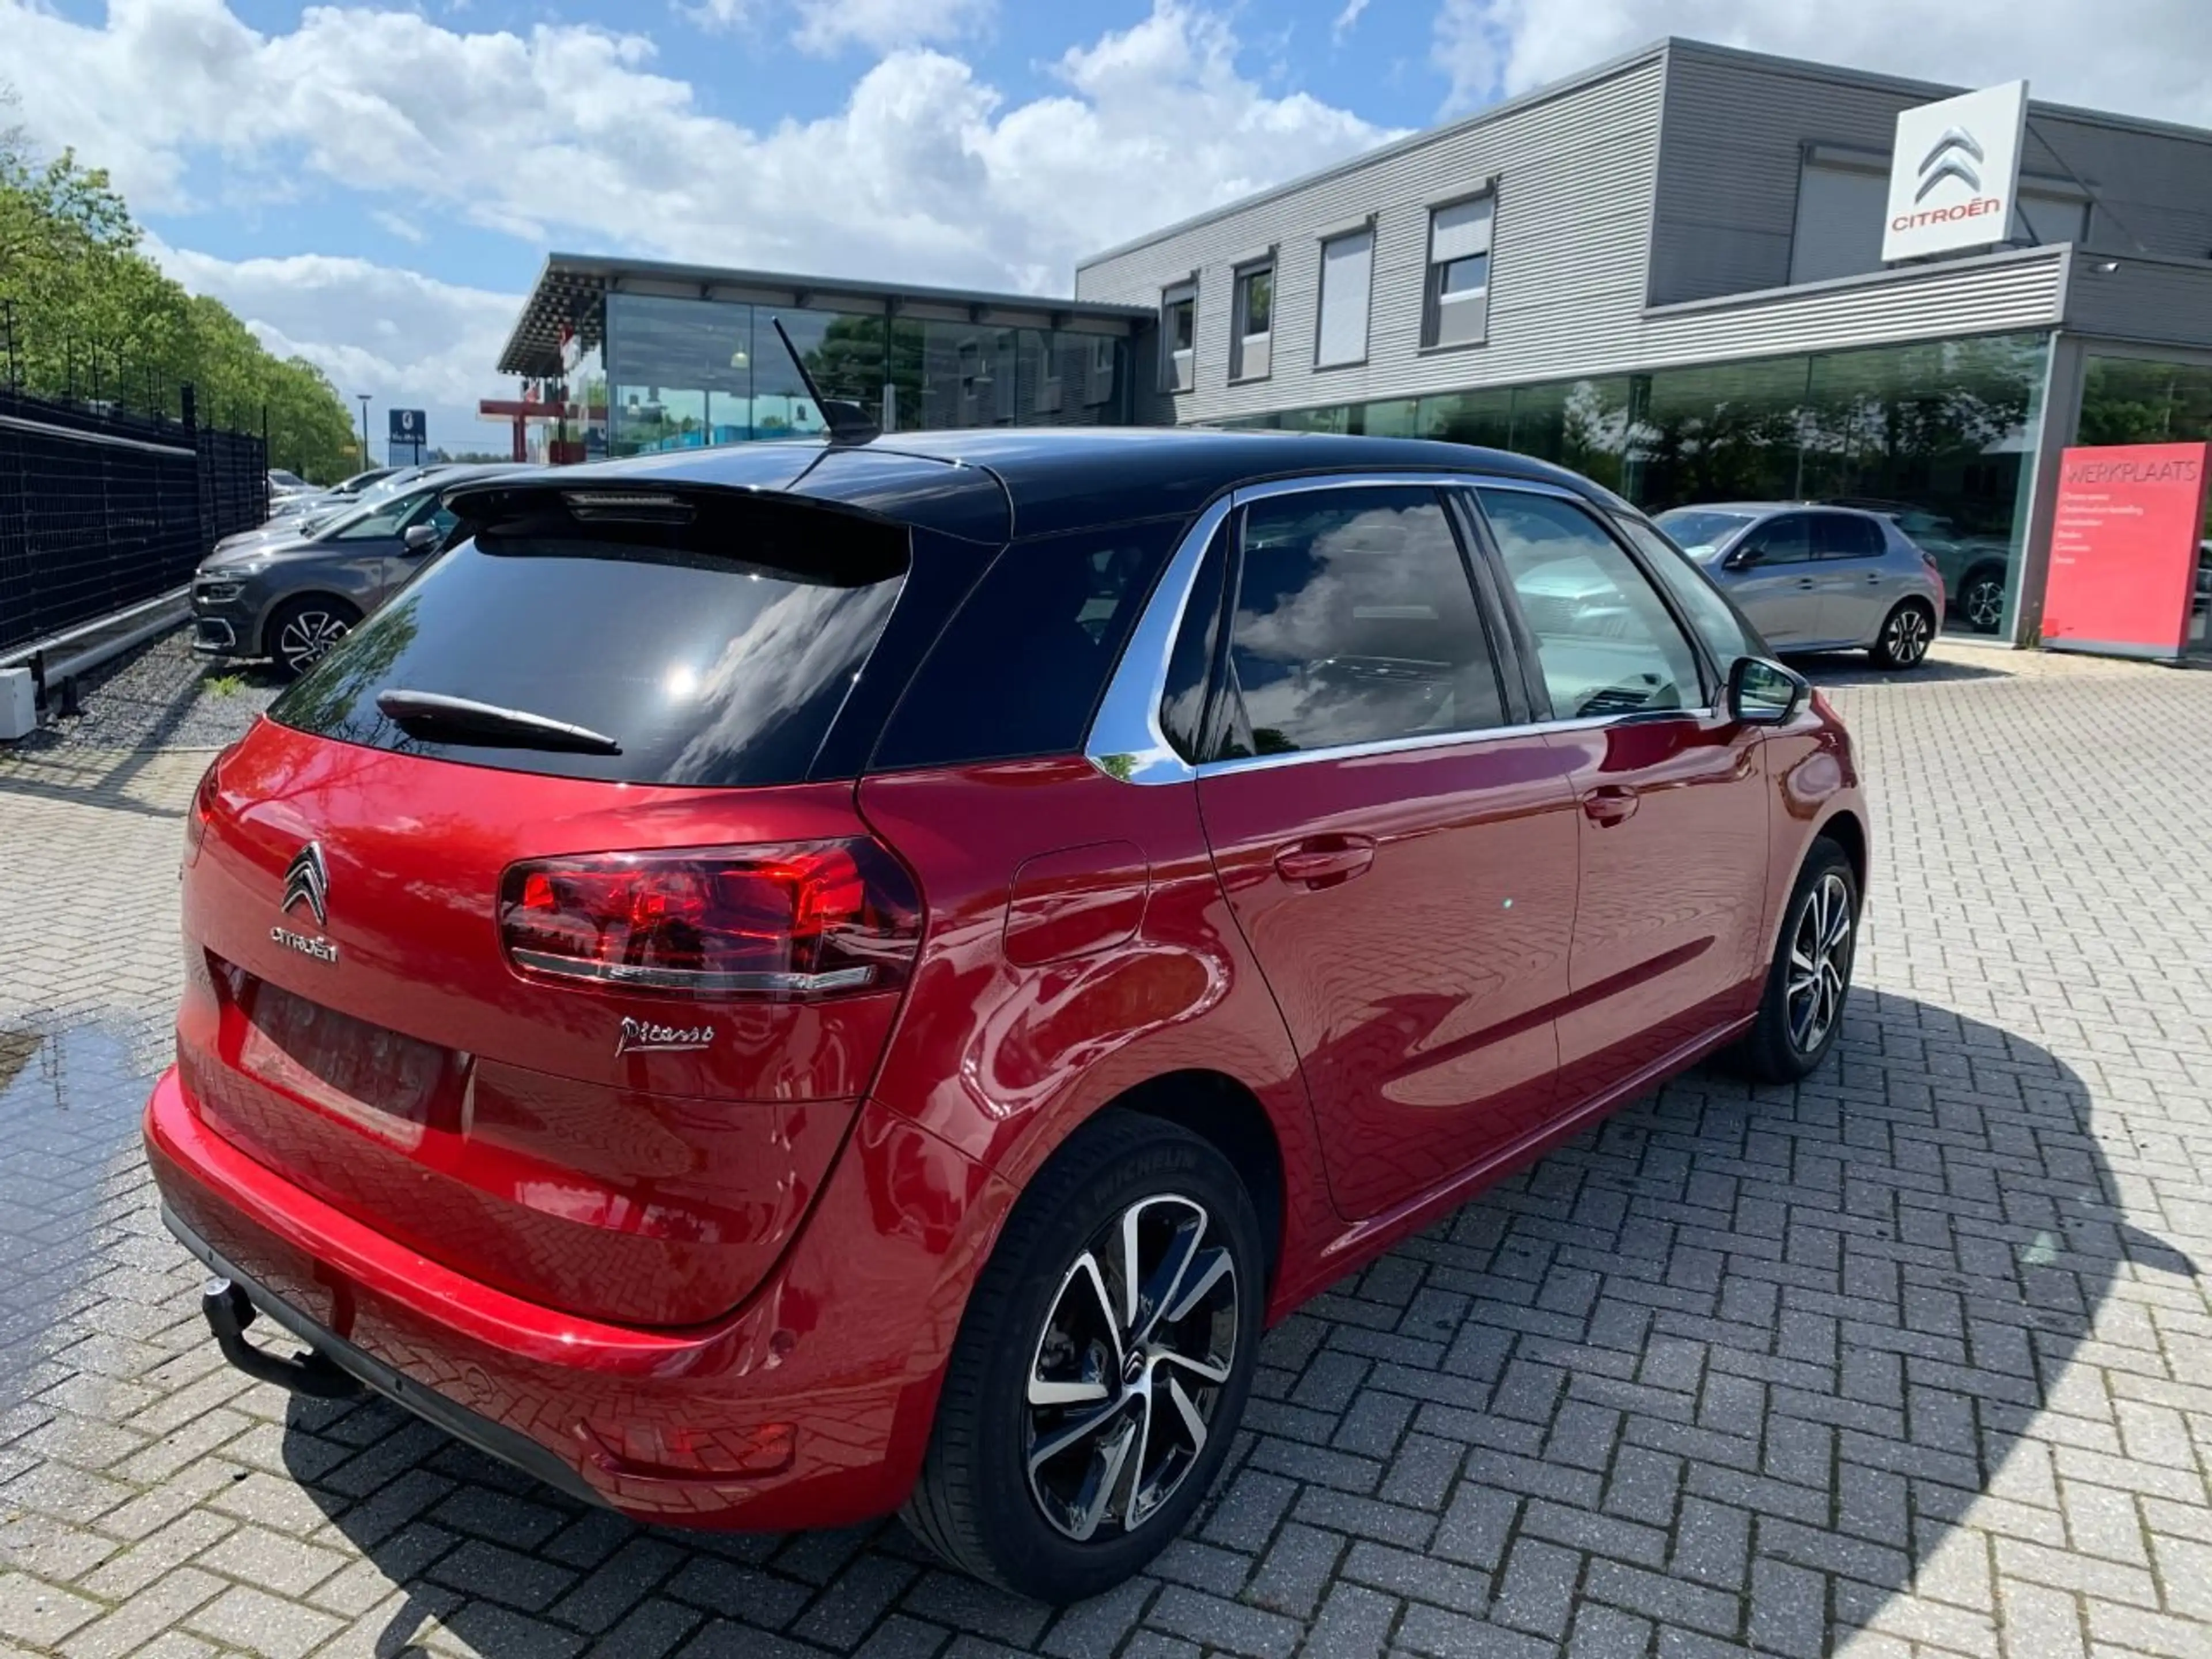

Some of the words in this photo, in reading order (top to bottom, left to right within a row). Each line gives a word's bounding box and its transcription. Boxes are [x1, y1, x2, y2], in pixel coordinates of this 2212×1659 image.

[2066, 461, 2197, 483] WERKPLAATS
[615, 1016, 714, 1058] Picasso
[1094, 1147, 1197, 1206] MICHELIN
